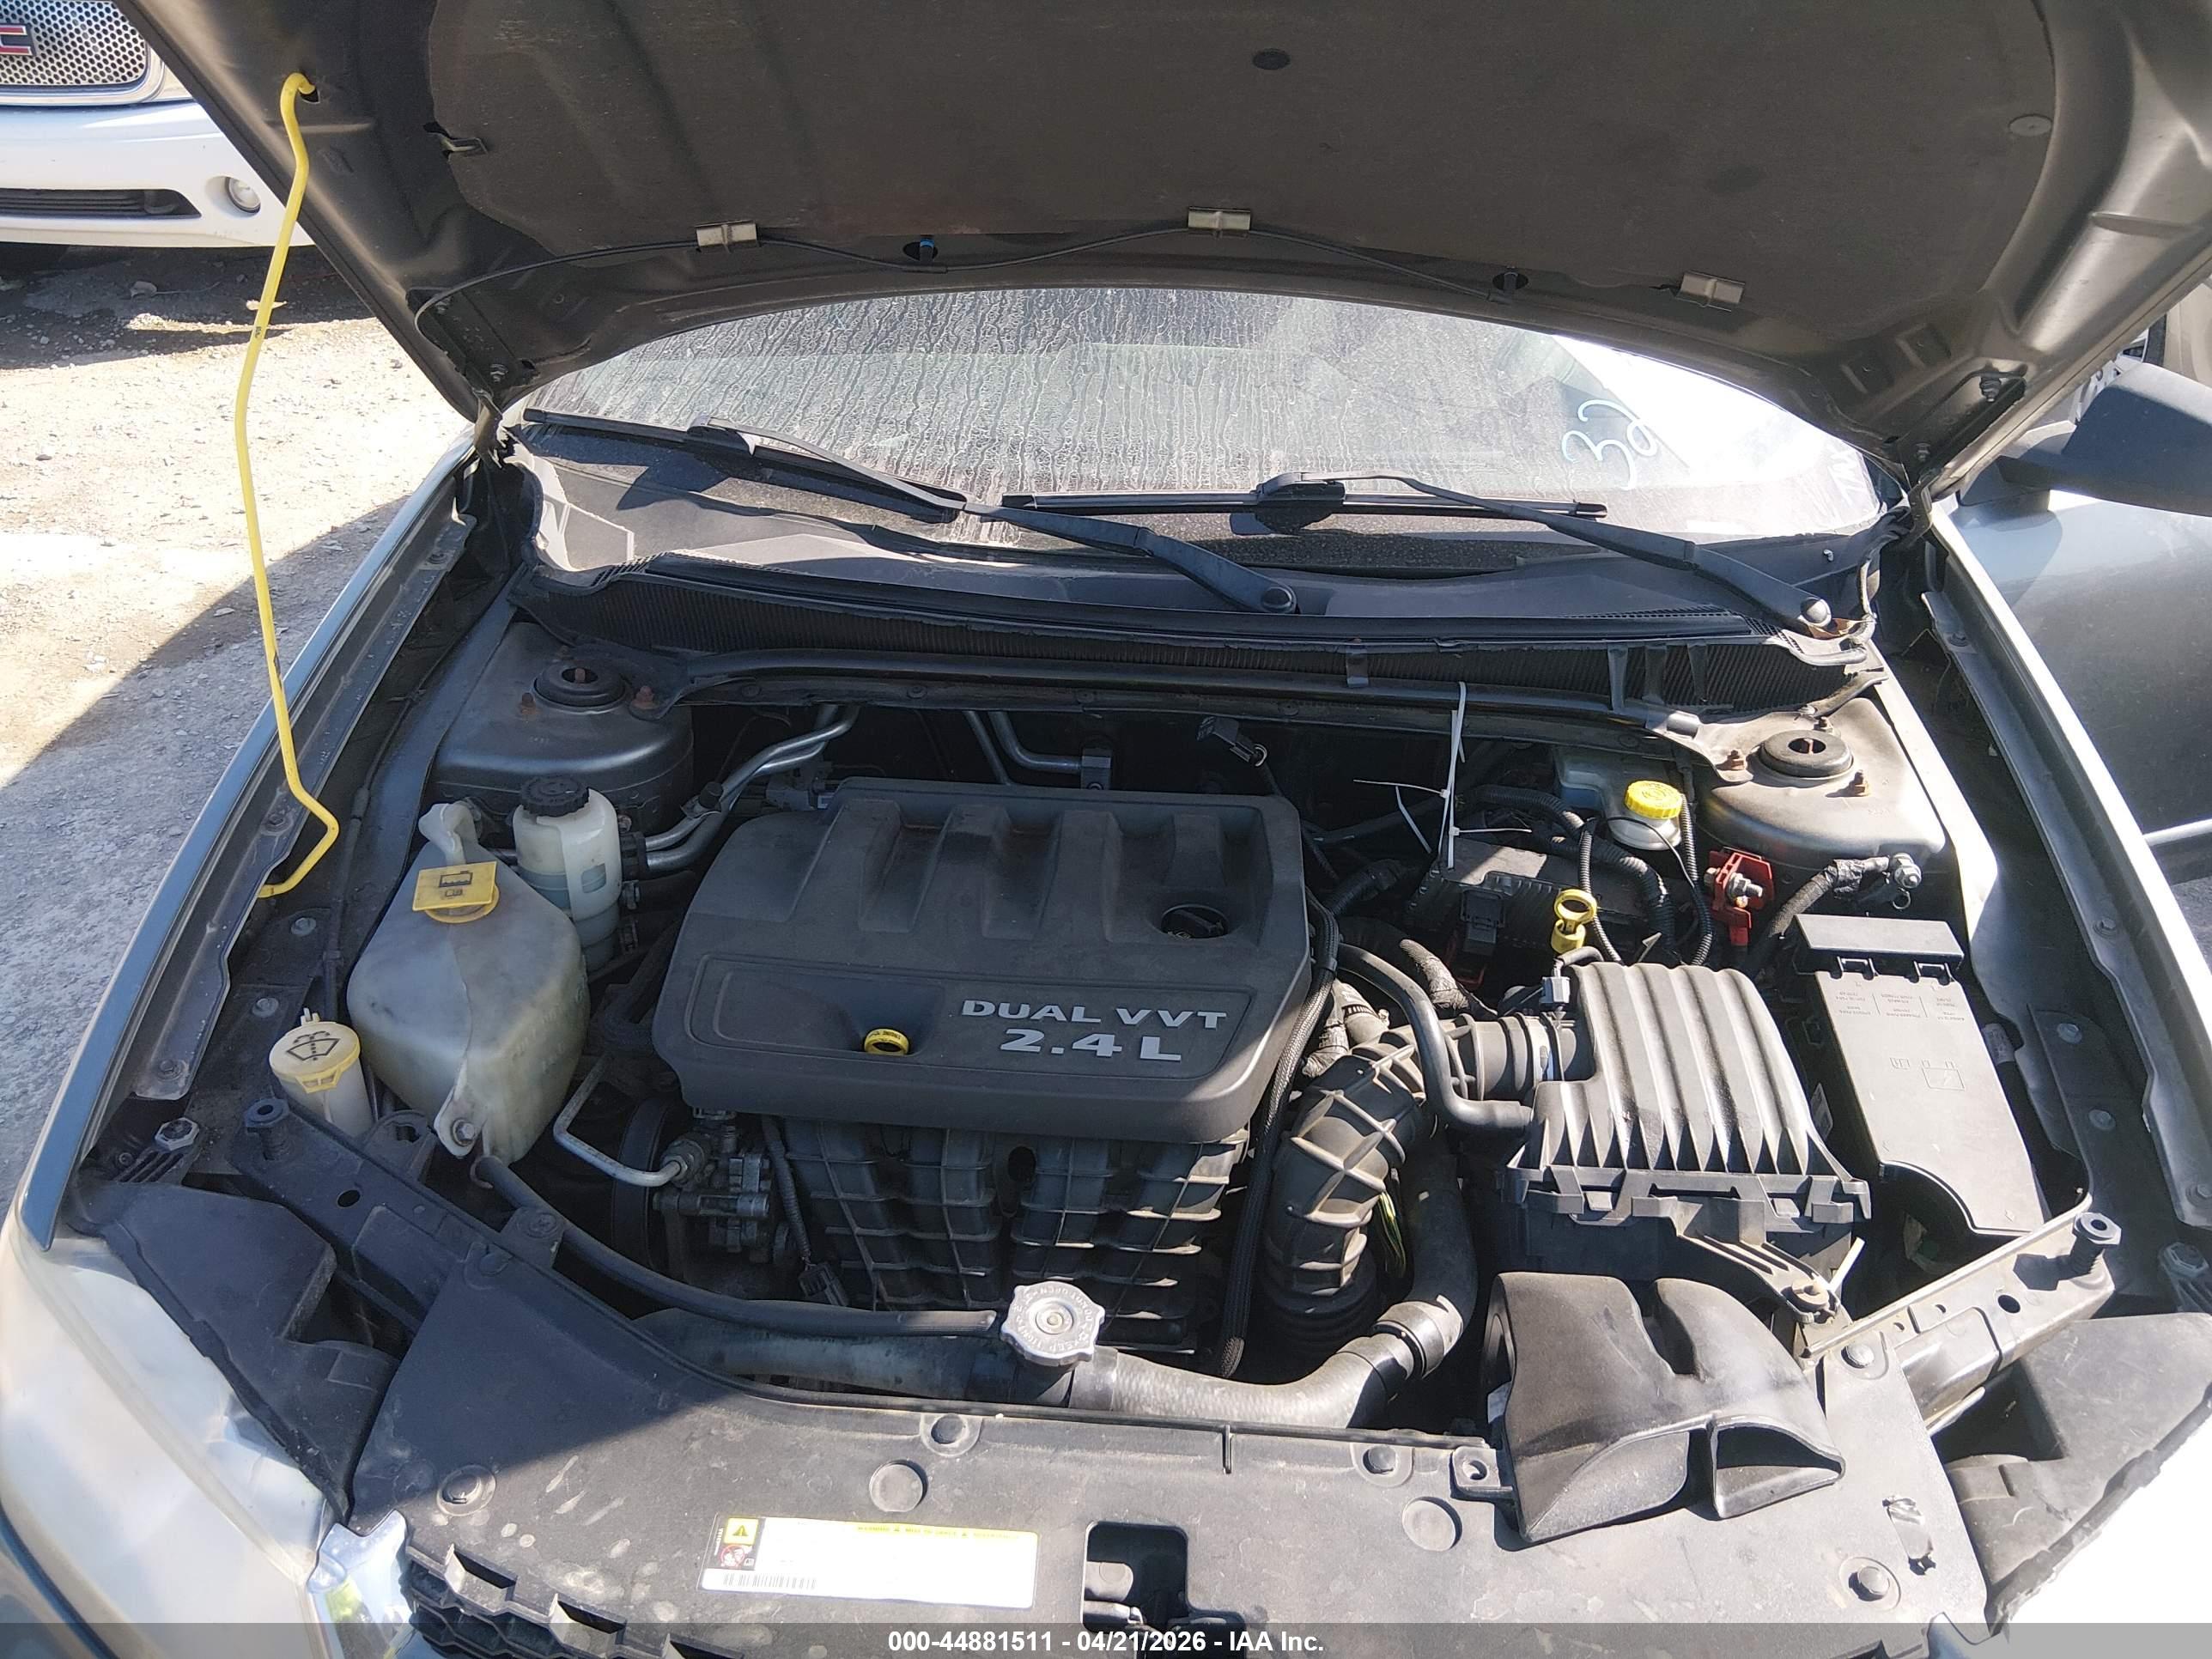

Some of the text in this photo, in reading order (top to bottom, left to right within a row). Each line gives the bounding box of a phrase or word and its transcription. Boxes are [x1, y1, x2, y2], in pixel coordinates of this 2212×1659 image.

[962, 1000, 1227, 1029] DUAL VVT
[1000, 1028, 1182, 1061] 2.4 L
